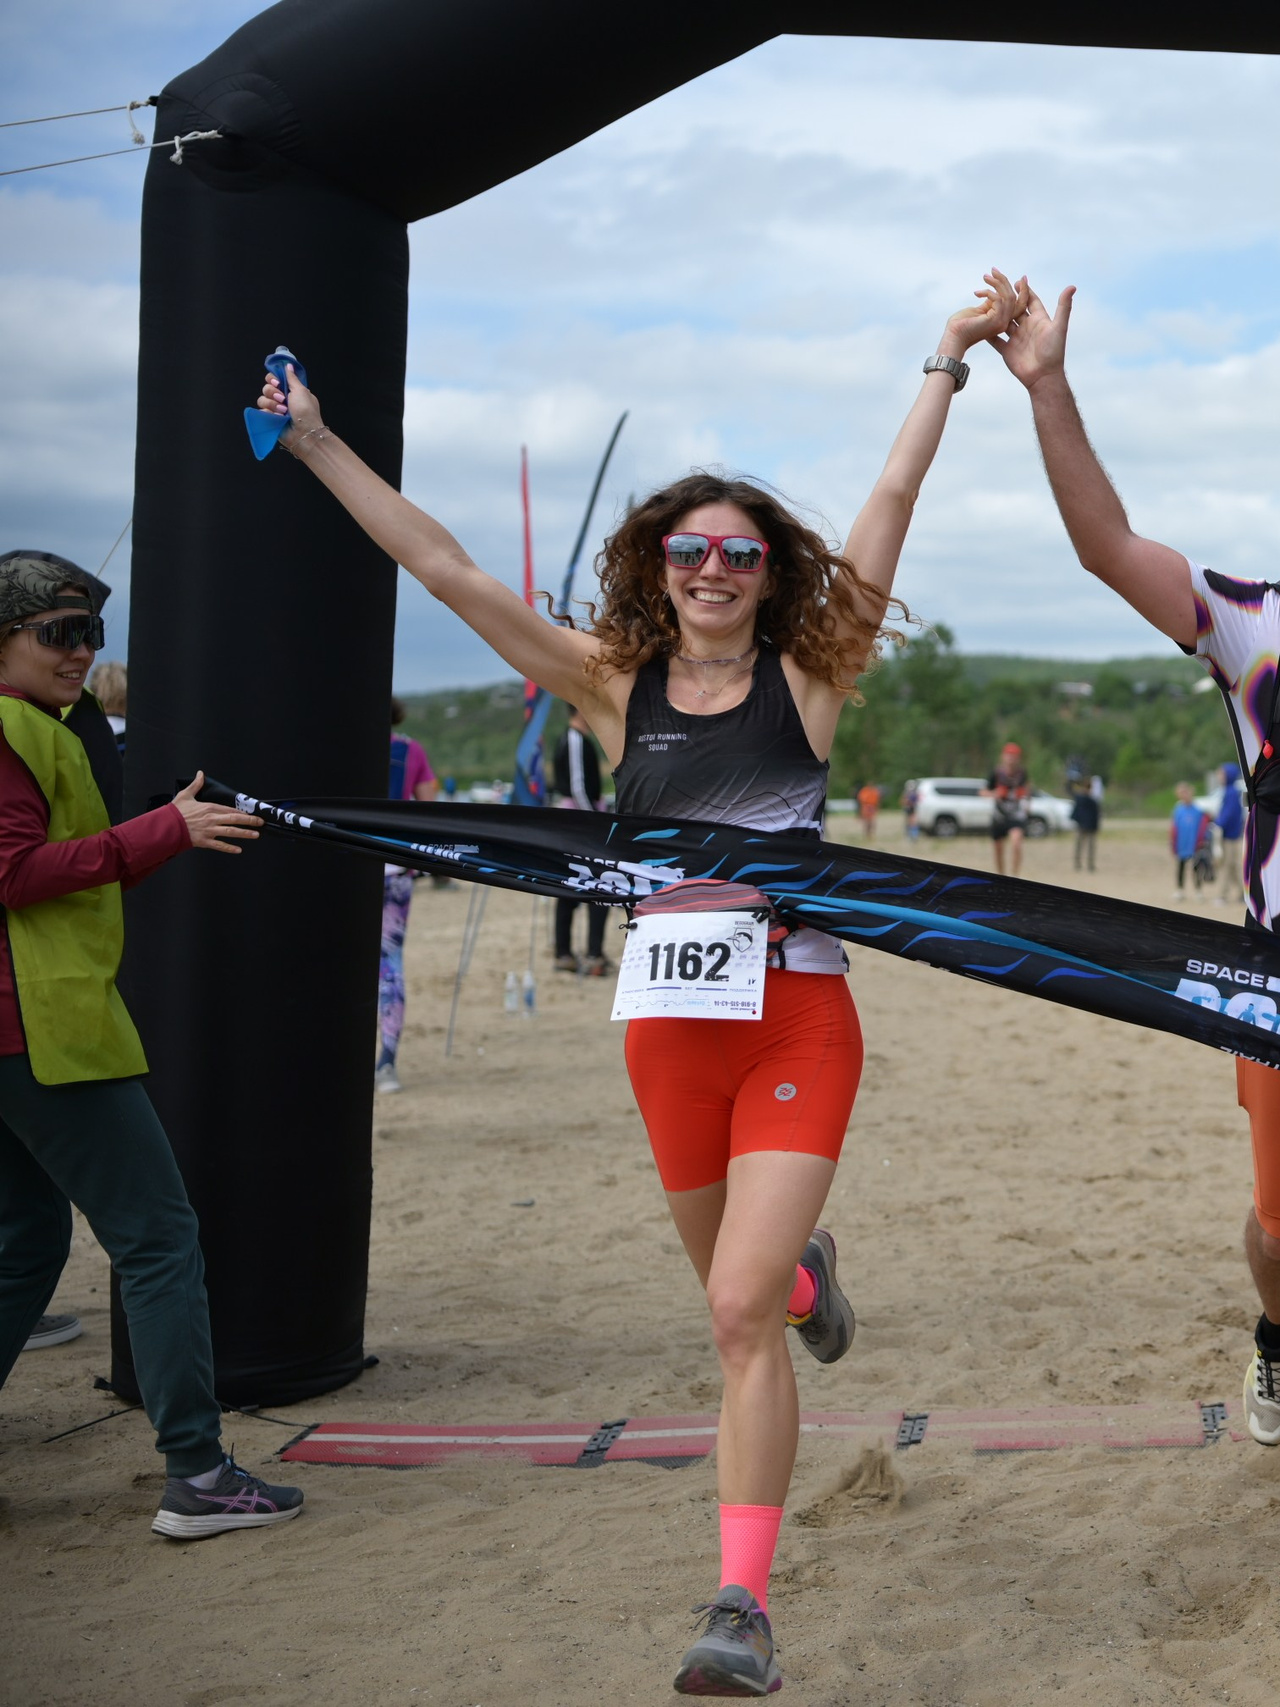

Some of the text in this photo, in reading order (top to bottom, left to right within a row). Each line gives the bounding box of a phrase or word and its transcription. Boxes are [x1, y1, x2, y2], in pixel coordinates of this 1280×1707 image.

[657, 732, 687, 741] RUNNING
[648, 743, 669, 752] SQUAD
[649, 941, 731, 982] 1162
[1186, 959, 1265, 988] SPACE
